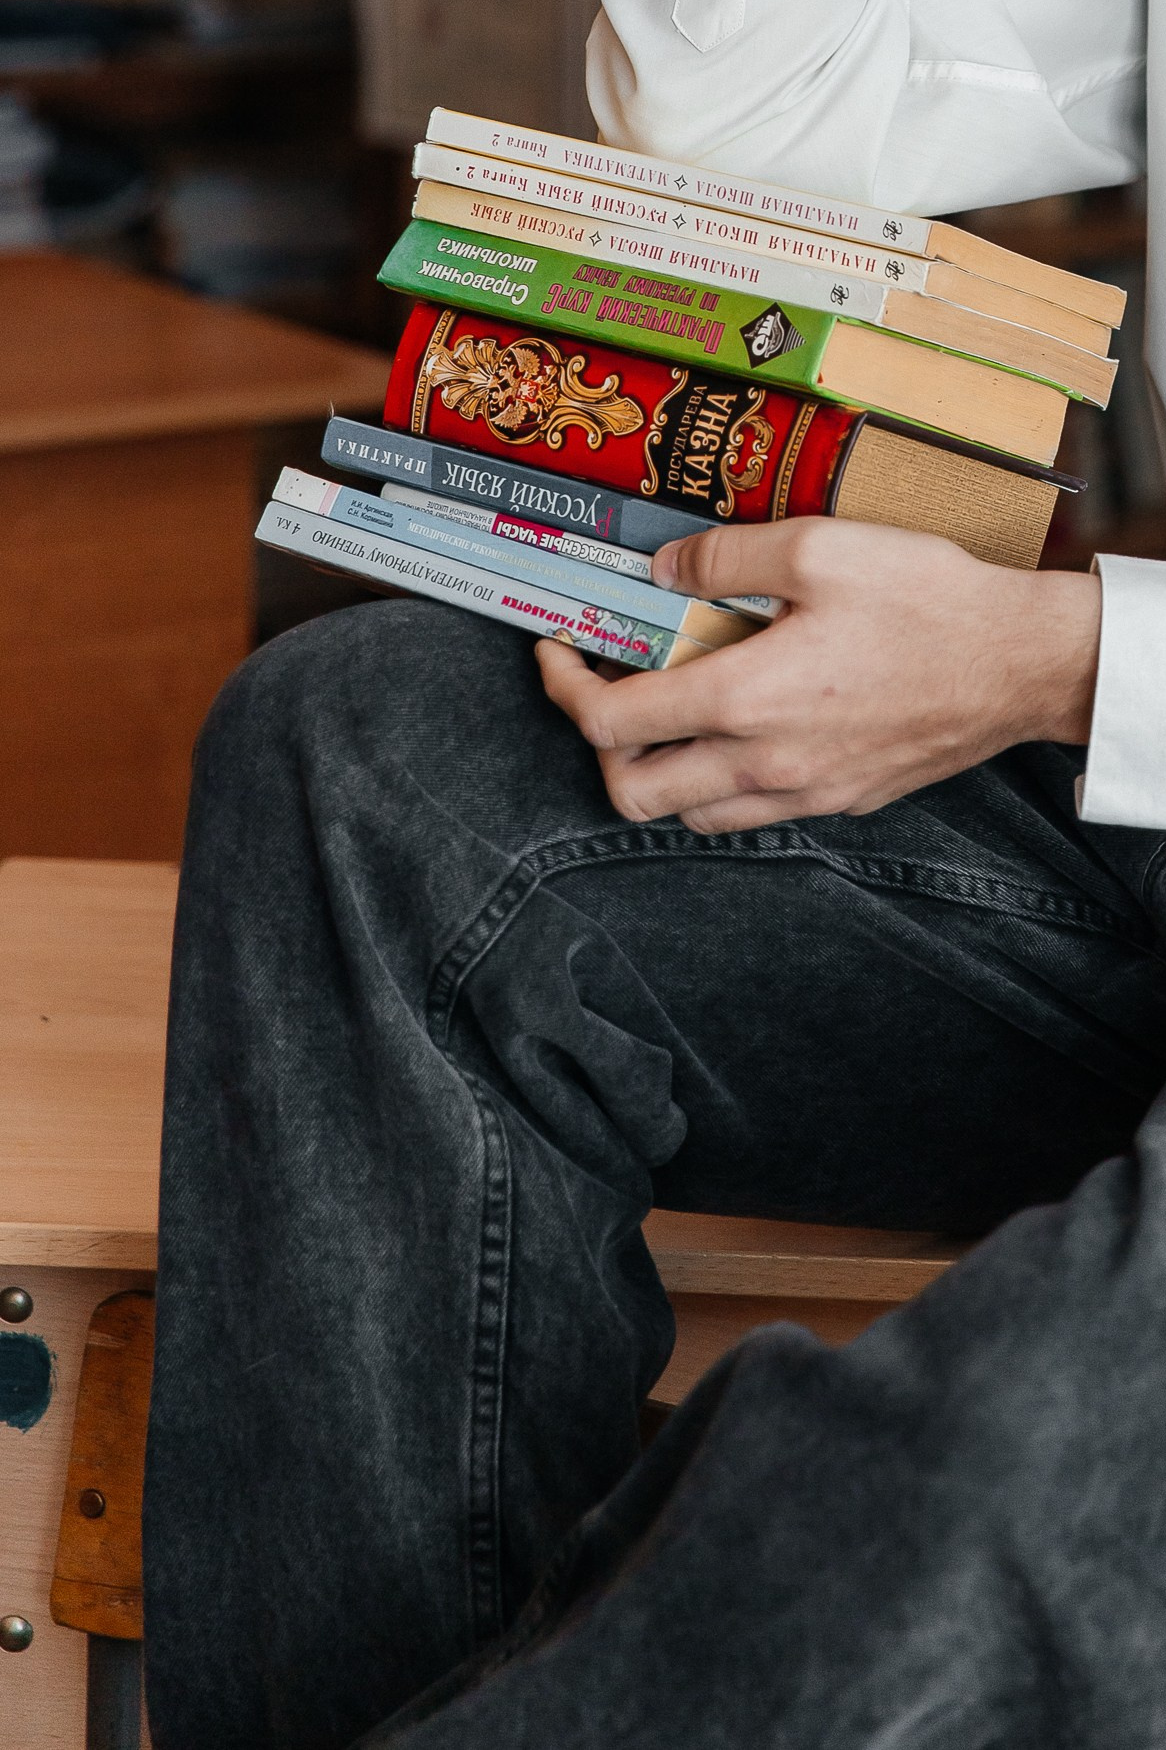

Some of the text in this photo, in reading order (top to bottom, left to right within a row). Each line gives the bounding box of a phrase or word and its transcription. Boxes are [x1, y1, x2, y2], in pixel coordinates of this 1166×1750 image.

[491, 133, 501, 147] 2
[507, 136, 548, 158] Книга
[466, 165, 476, 179] 2
[482, 169, 528, 192] Книга
[563, 149, 670, 187] МАТЕМАТИКА
[536, 181, 584, 204] ЯЗЫК
[591, 194, 668, 224] РУССКИЙ
[696, 180, 754, 206] ШКОЛА
[761, 196, 859, 231] НАЧАЛЬНАЯ
[470, 202, 760, 283] НАЧАЛЬНАЯ ШКОЛА РУССКИЙ ЯЗЫК
[694, 218, 758, 245] ШКОЛА
[436, 237, 538, 274] школьника
[768, 235, 876, 273] НАЧАЛЬНАЯ
[417, 259, 529, 306] Справочник
[572, 263, 721, 312] ПО РУССКОМУ ЯЗЫКУ
[595, 295, 726, 354] ПРАКТИЧЕСКИЙ
[666, 385, 708, 491] ГОСУДАРЕВА
[681, 392, 738, 499] КАЗНА
[336, 438, 427, 475] ПРАКТИКА
[427, 501, 449, 512] ШКОЛЕ
[442, 461, 614, 538] Русский язык
[291, 523, 301, 535] 4
[312, 529, 365, 561] ЧТЕНИЮ
[496, 521, 621, 568] КЛАССНЫЕ ЧАСЫ
[366, 551, 473, 594] ЛИТЕРАТУРНОМУ
[629, 558, 649, 575] час
[473, 585, 495, 602] ПО
[500, 594, 575, 629] РАЗРАБОТКИ
